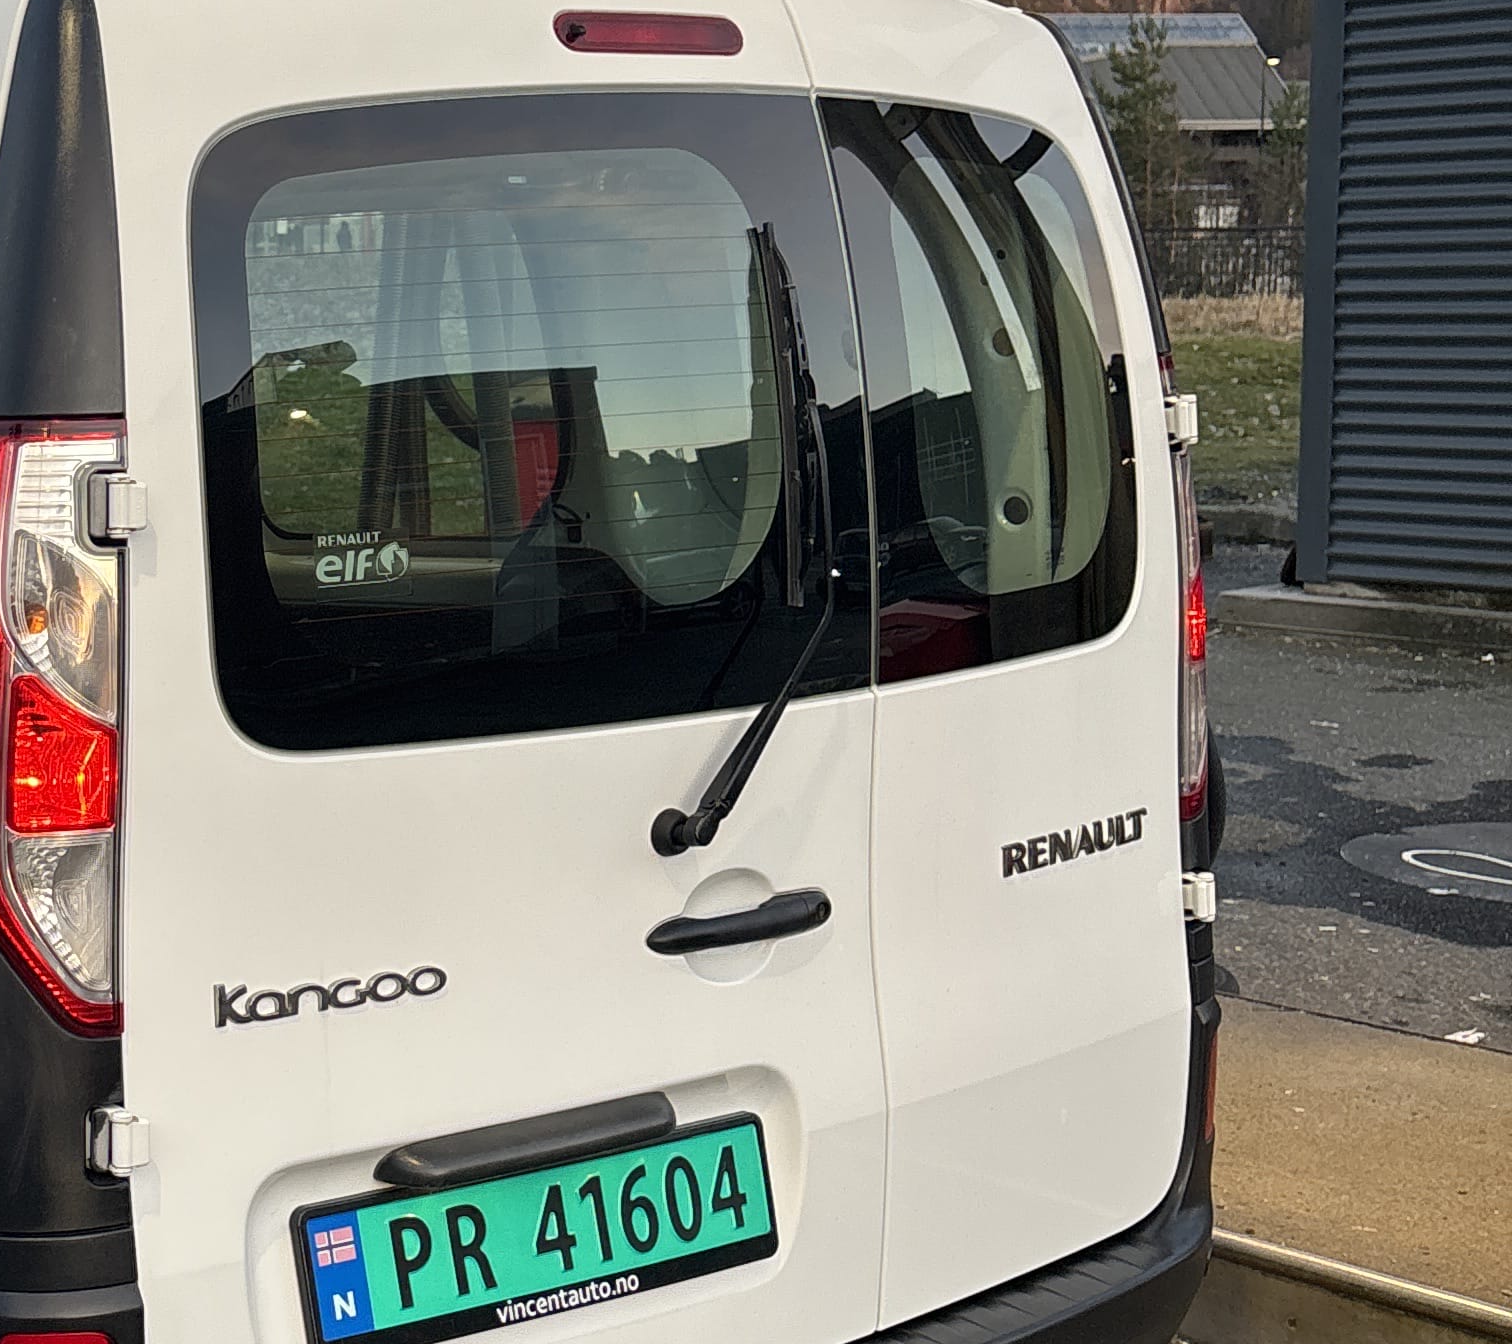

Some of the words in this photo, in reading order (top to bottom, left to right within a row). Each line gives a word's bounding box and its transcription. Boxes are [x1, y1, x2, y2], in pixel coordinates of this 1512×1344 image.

[317, 531, 382, 548] RENAULT
[315, 548, 375, 584] elf
[1001, 807, 1148, 878] RENAULT
[213, 965, 448, 1028] Kangoo
[388, 1204, 498, 1310] PR
[536, 1145, 749, 1272] 41604
[332, 1289, 357, 1322] N
[496, 1273, 640, 1325] vincentauto.no
